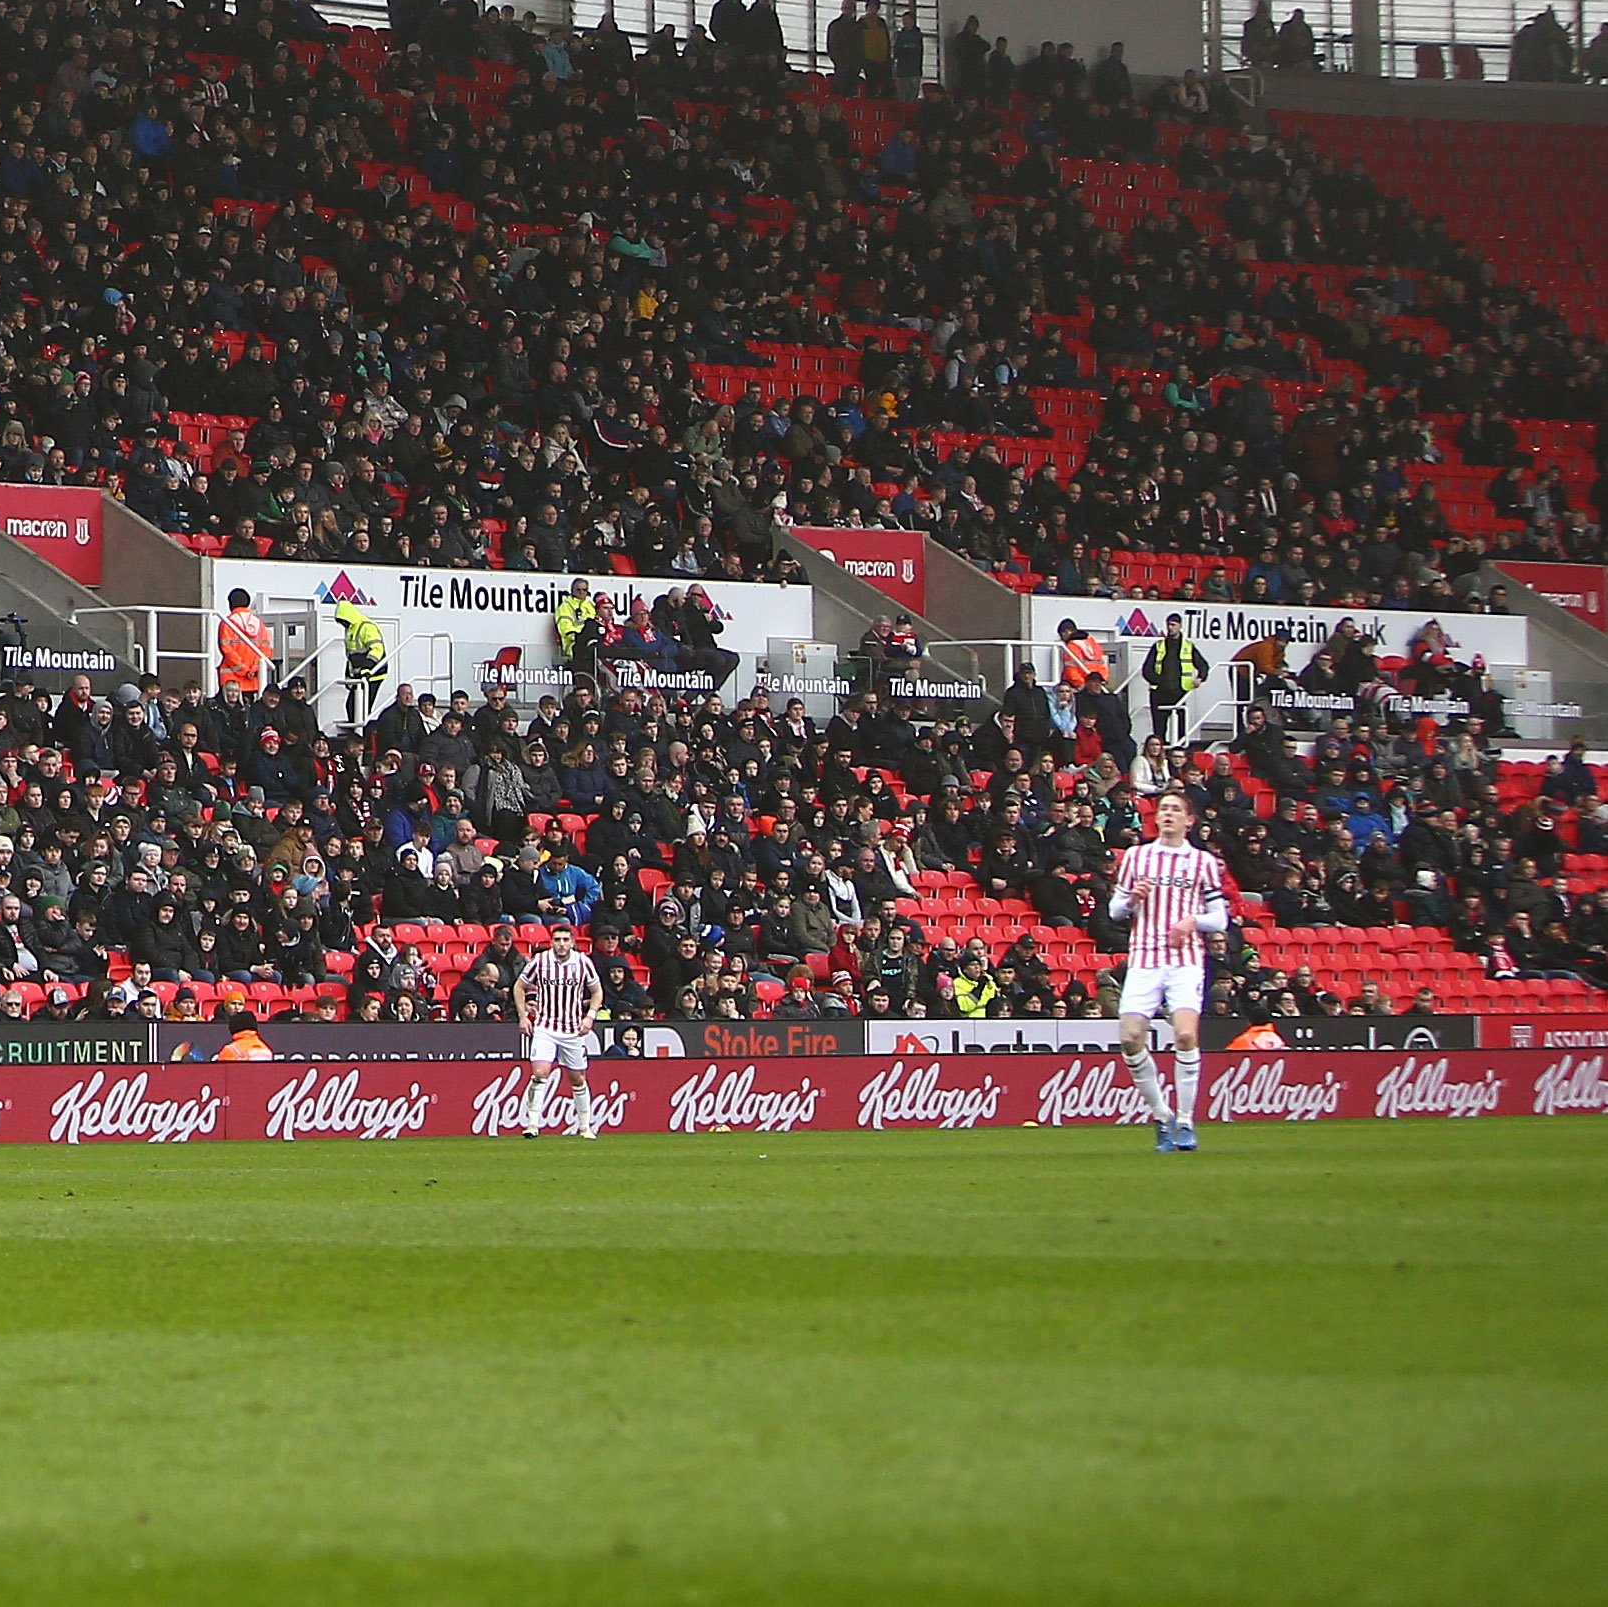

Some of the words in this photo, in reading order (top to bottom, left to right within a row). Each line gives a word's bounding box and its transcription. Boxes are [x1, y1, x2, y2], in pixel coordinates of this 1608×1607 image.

[6, 518, 68, 539] macron
[844, 560, 896, 577] macron
[400, 575, 444, 610] Tile
[1185, 609, 1222, 640] Tile
[3, 646, 33, 668] Tile
[35, 648, 115, 671] Mountain
[472, 663, 498, 684] Tile
[501, 664, 573, 686] Mountain
[616, 667, 641, 689] Tile
[644, 668, 714, 691] Mountain
[782, 673, 851, 696] Mountain
[889, 677, 915, 698] Tile
[917, 678, 981, 700] Mountain
[1270, 689, 1291, 708] Tile
[1293, 691, 1355, 710] Mountain
[703, 1024, 780, 1057] Stoke
[786, 1025, 839, 1056] Fire
[669, 1063, 819, 1134] Kellogg's
[857, 1060, 1002, 1131] Kellogg's
[1208, 1056, 1341, 1123] Kellogg's
[1374, 1056, 1503, 1119] Kellogg's
[50, 1070, 222, 1144] Kellogg's
[266, 1067, 430, 1141] Kellogg's
